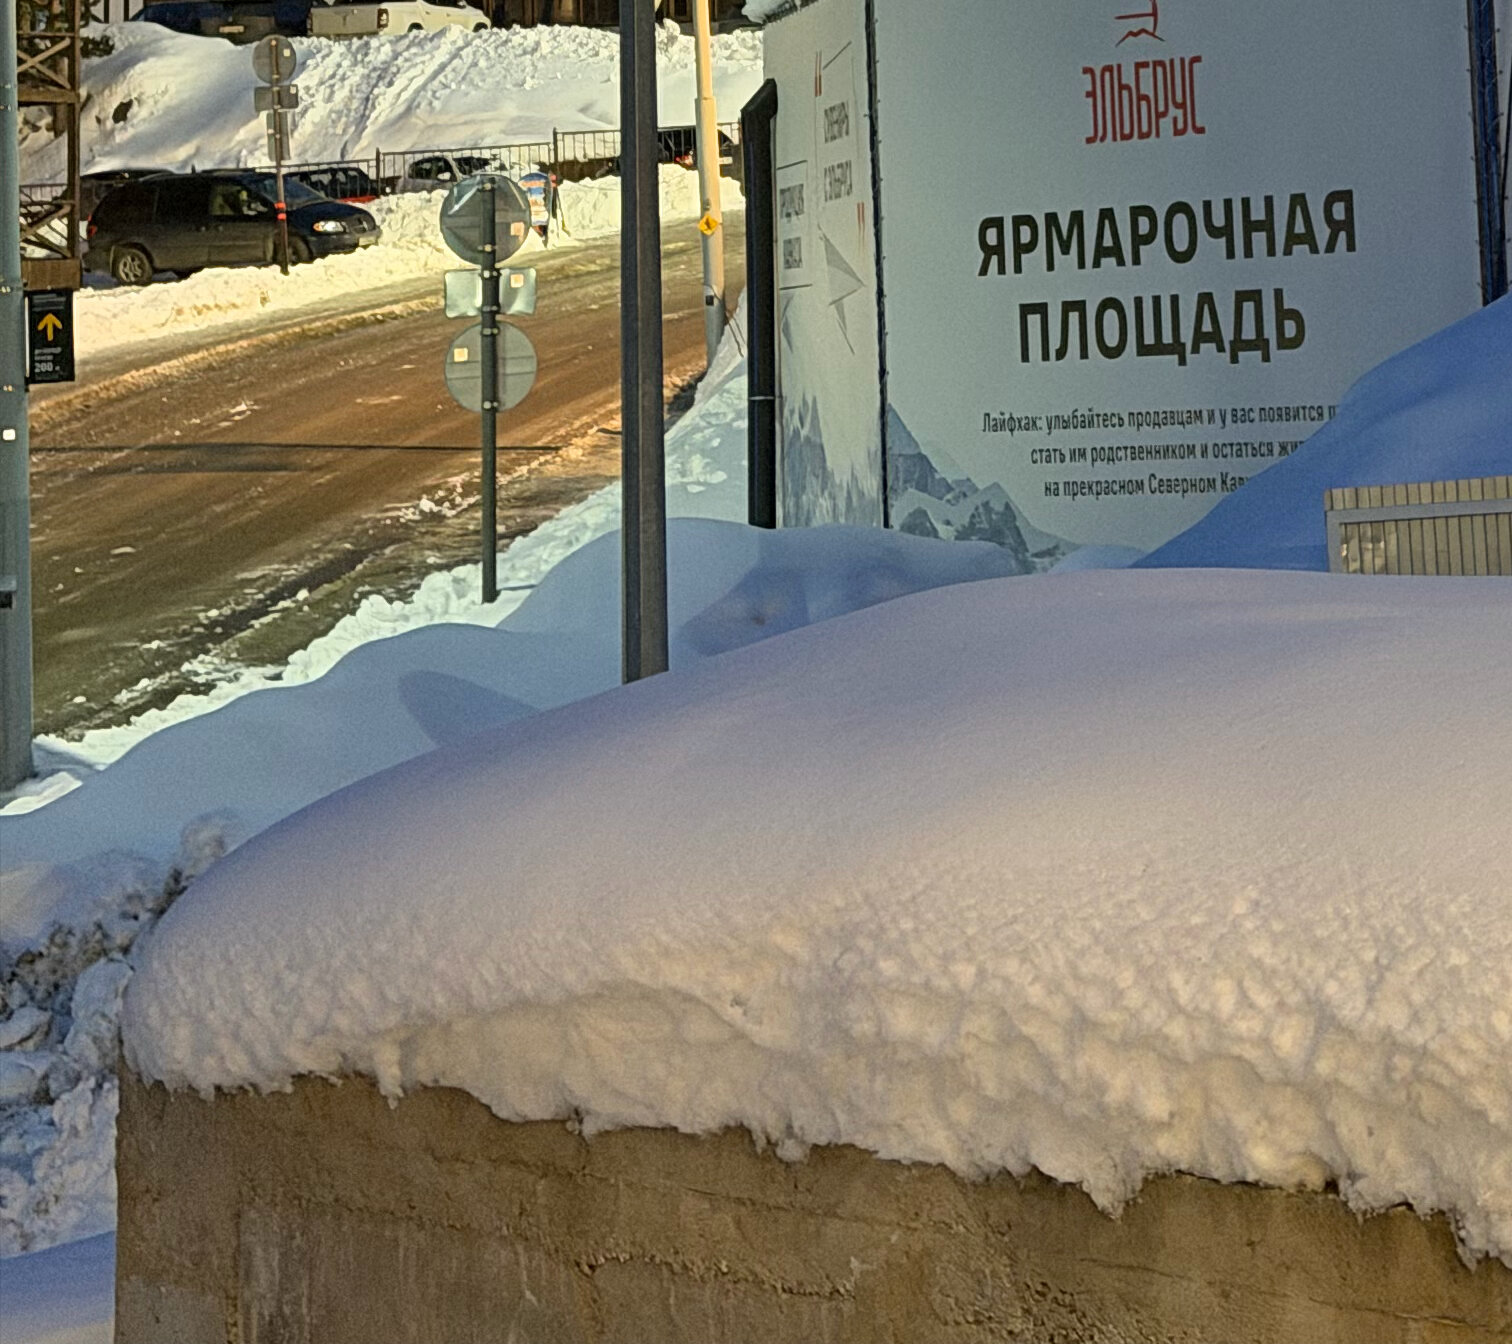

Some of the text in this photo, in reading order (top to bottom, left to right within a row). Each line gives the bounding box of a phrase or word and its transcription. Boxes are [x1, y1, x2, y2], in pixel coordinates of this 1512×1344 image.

[1082, 55, 1206, 145] ЭЛЬБРУС
[977, 189, 1357, 277] ЯРМАРОЧНАЯ
[1018, 288, 1307, 367] ПЛОЩАДЬ
[982, 410, 1043, 437] Лайфхак:
[1045, 406, 1125, 436] улыбайтесь
[1127, 408, 1204, 432] продавцам
[1207, 408, 1216, 425] и
[1219, 408, 1227, 430] у
[1231, 407, 1256, 424] вас
[1258, 404, 1325, 423] появится
[1030, 440, 1305, 468] стать им родственником и остаться жи
[1044, 471, 1249, 501] на прекрасном Северном Кав
